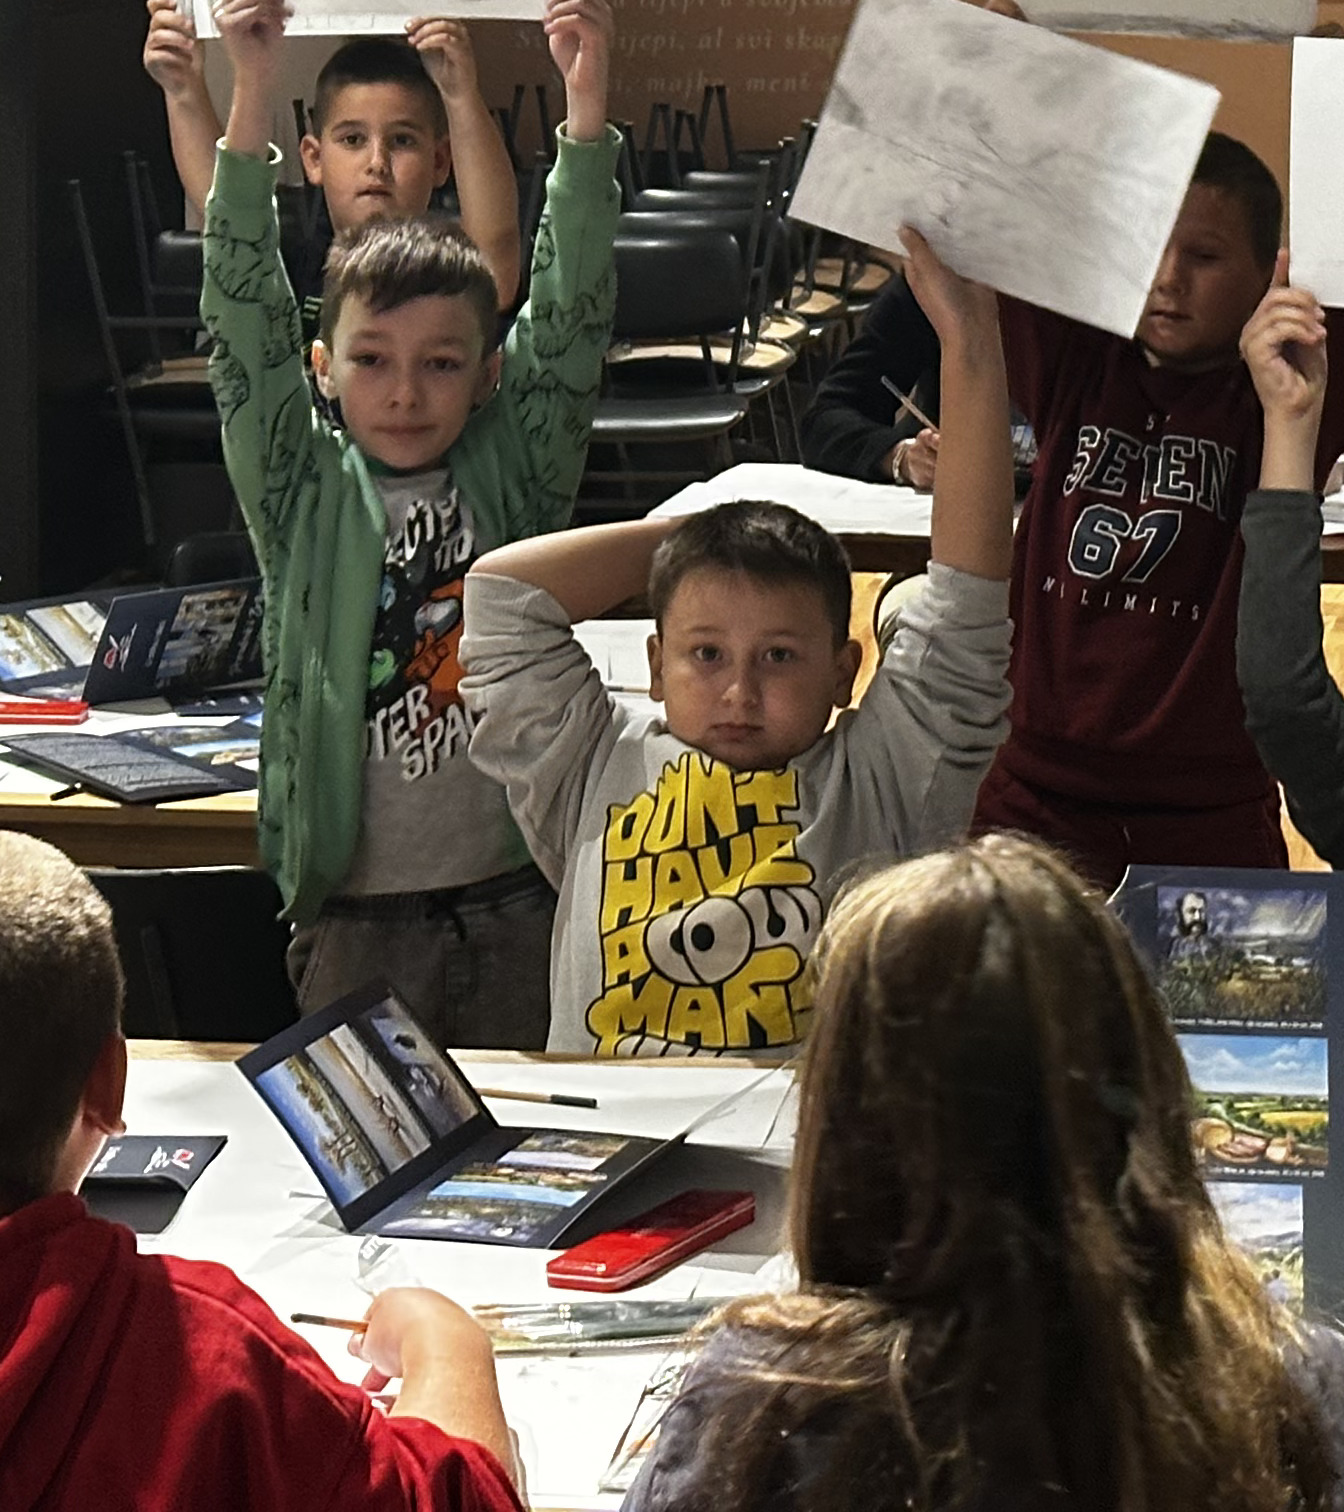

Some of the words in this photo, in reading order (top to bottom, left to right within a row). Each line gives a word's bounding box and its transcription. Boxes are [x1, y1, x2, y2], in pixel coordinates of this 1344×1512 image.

[1067, 503, 1183, 583] 67
[600, 821, 816, 938] HAVE
[588, 972, 798, 1050] MAN
